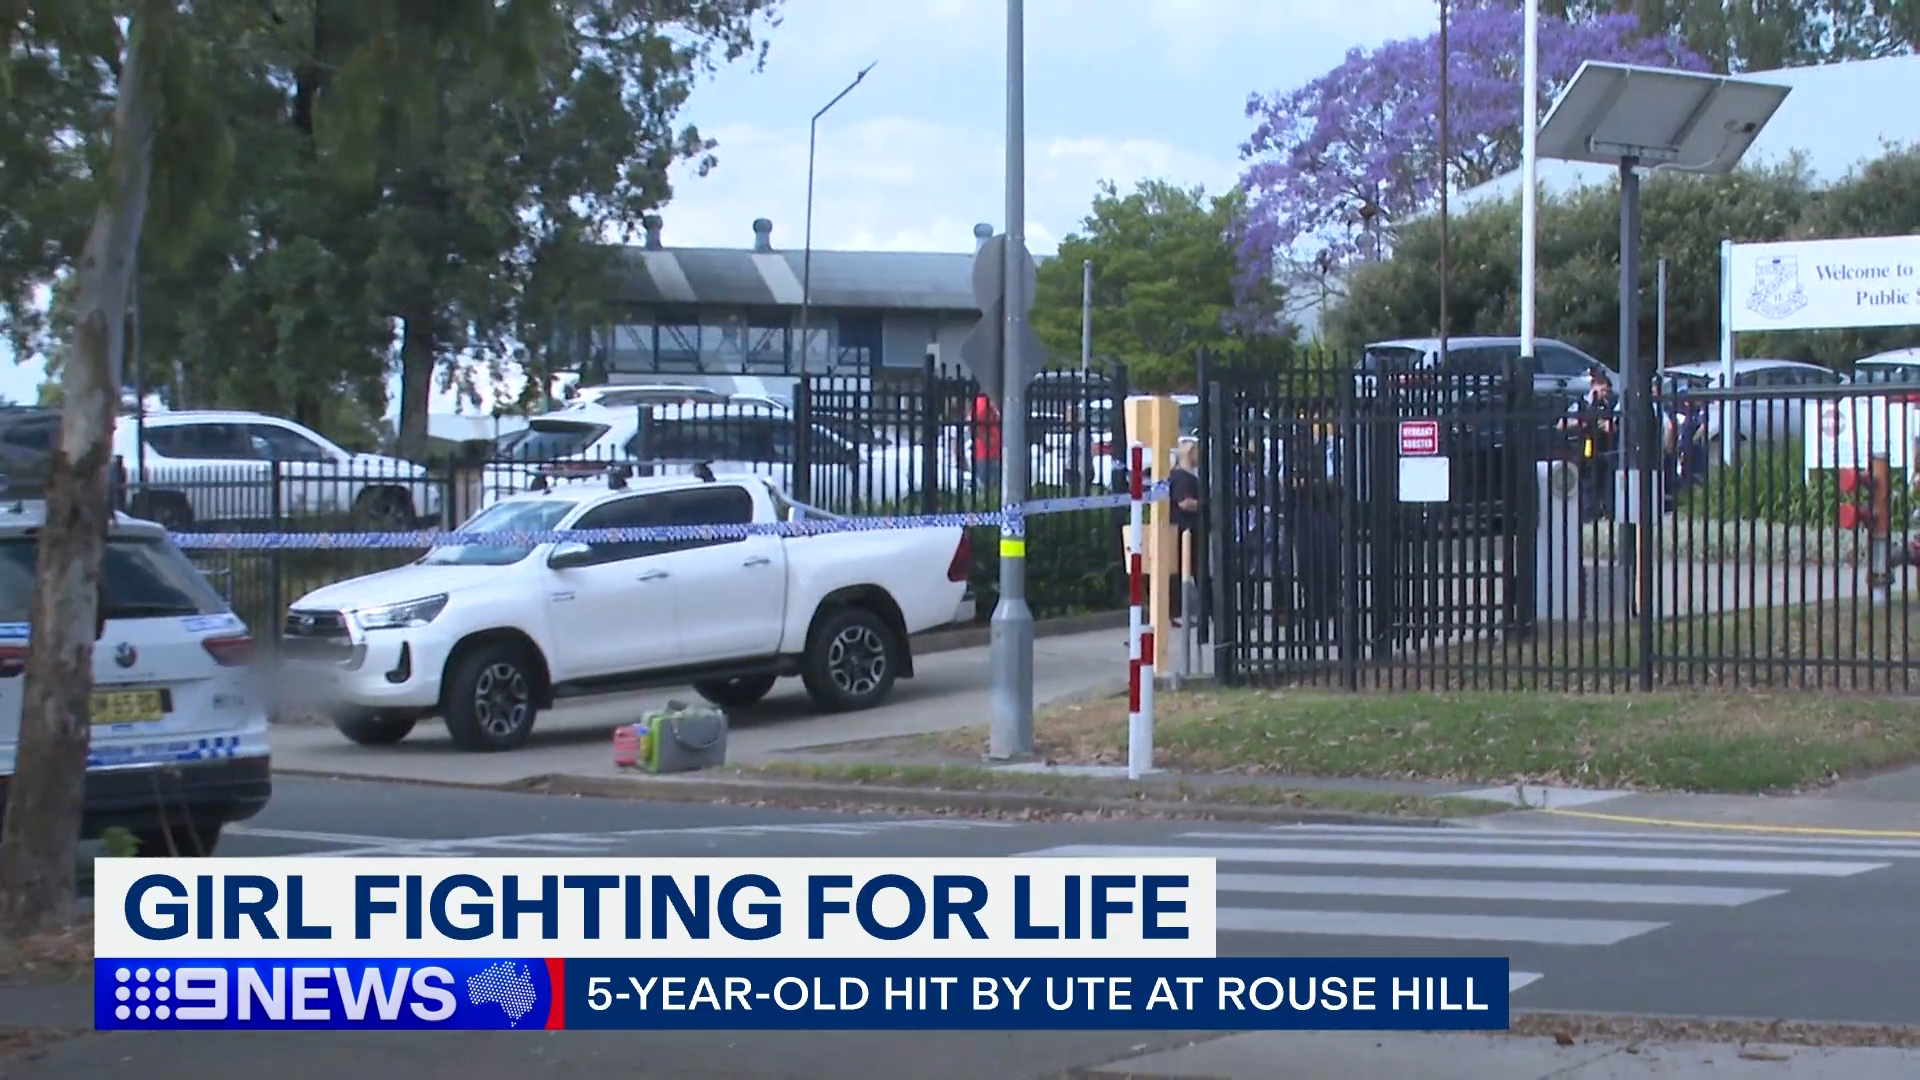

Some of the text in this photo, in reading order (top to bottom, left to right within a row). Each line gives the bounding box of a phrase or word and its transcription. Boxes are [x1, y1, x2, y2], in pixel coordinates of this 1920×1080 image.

[1816, 264, 1914, 281] Welcome to
[1856, 288, 1910, 306] Public
